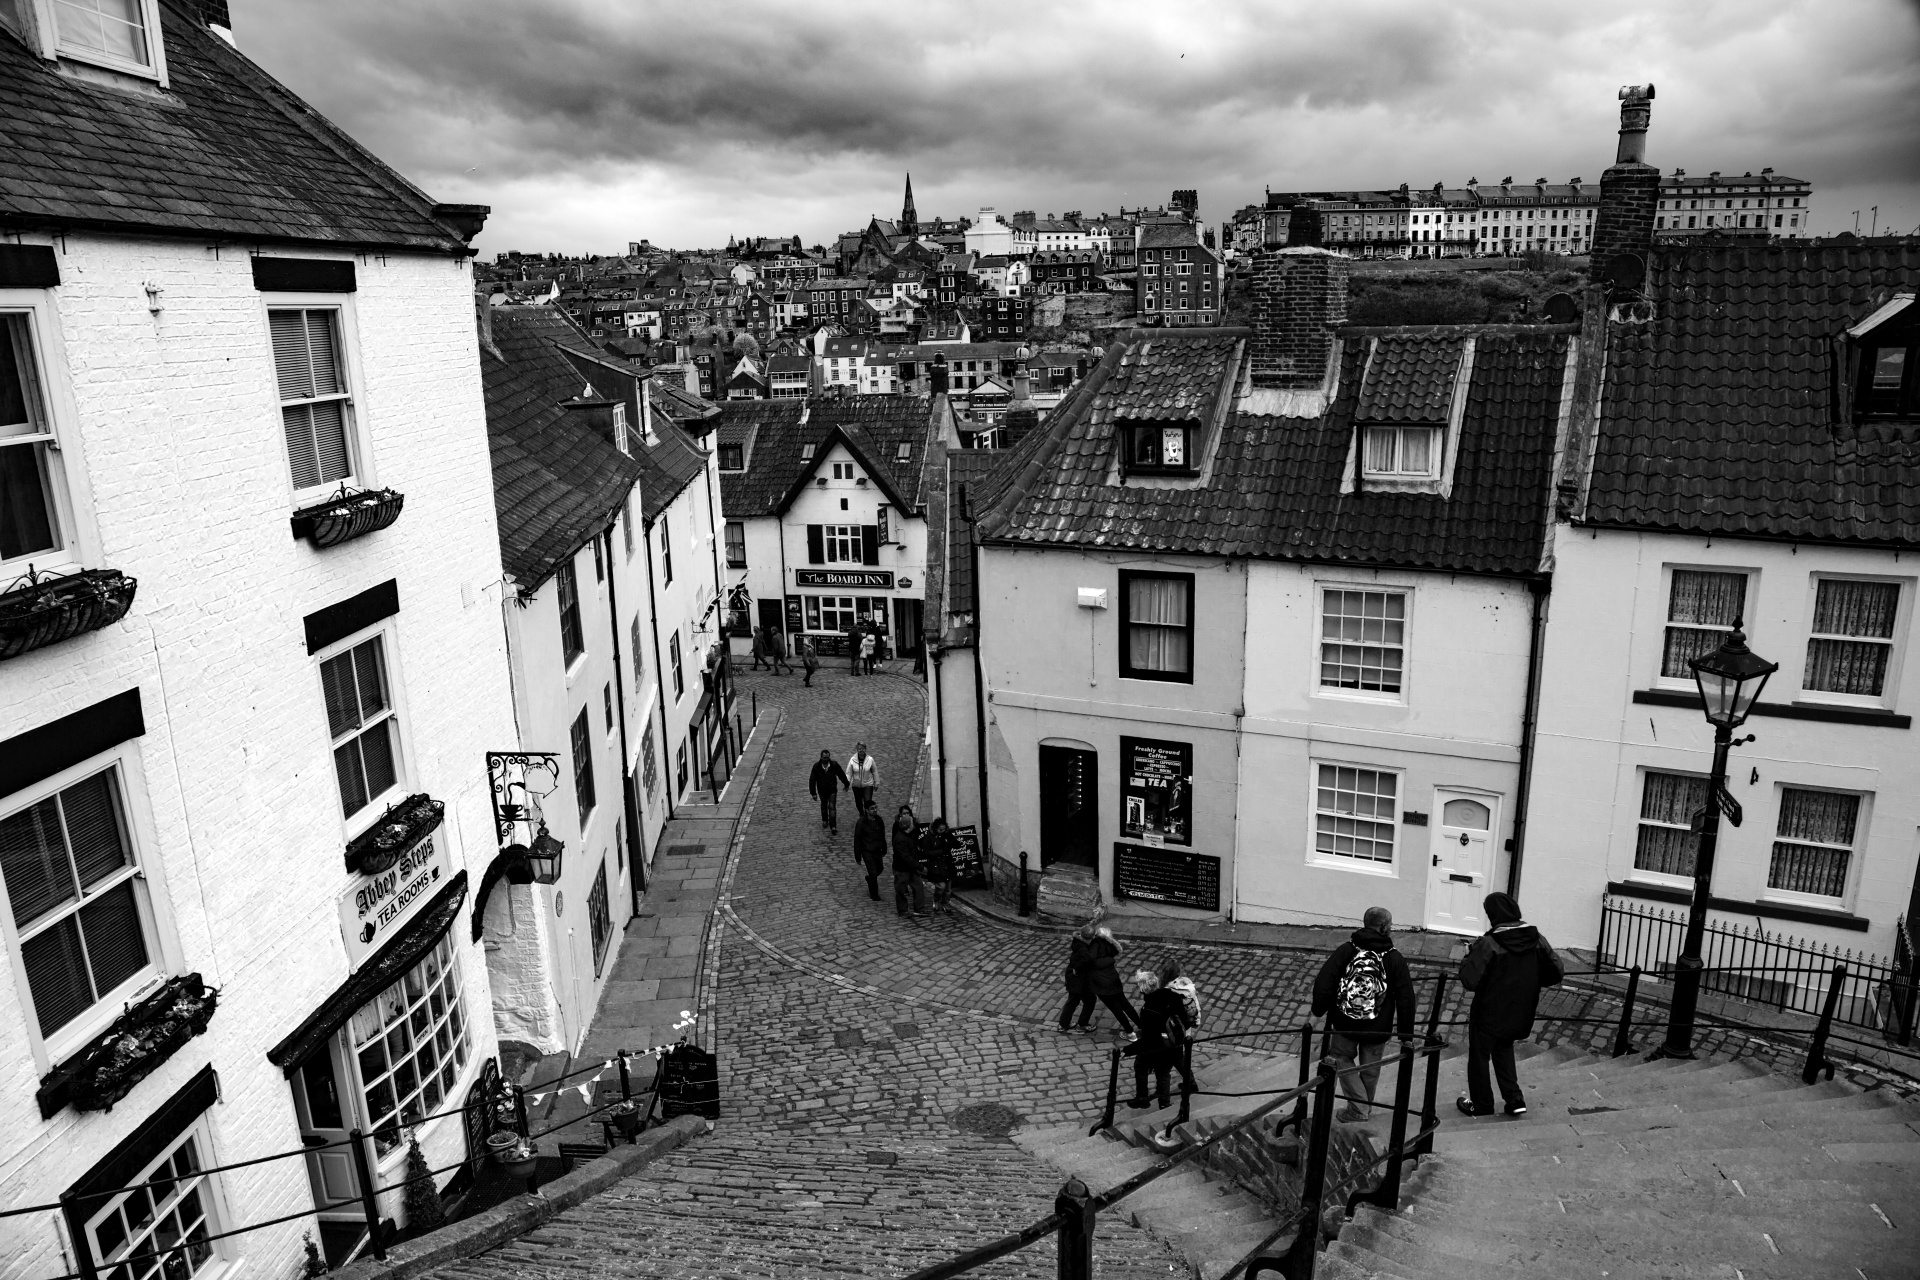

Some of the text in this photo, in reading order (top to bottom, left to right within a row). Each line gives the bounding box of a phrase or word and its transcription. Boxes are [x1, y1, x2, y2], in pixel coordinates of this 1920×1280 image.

[806, 574, 884, 585] The BOARD INN
[1148, 778, 1167, 788] TEA
[356, 836, 435, 920] Abbey Steps
[378, 872, 429, 926] TEA ROOMS
[416, 1029, 429, 1044] OPEN
